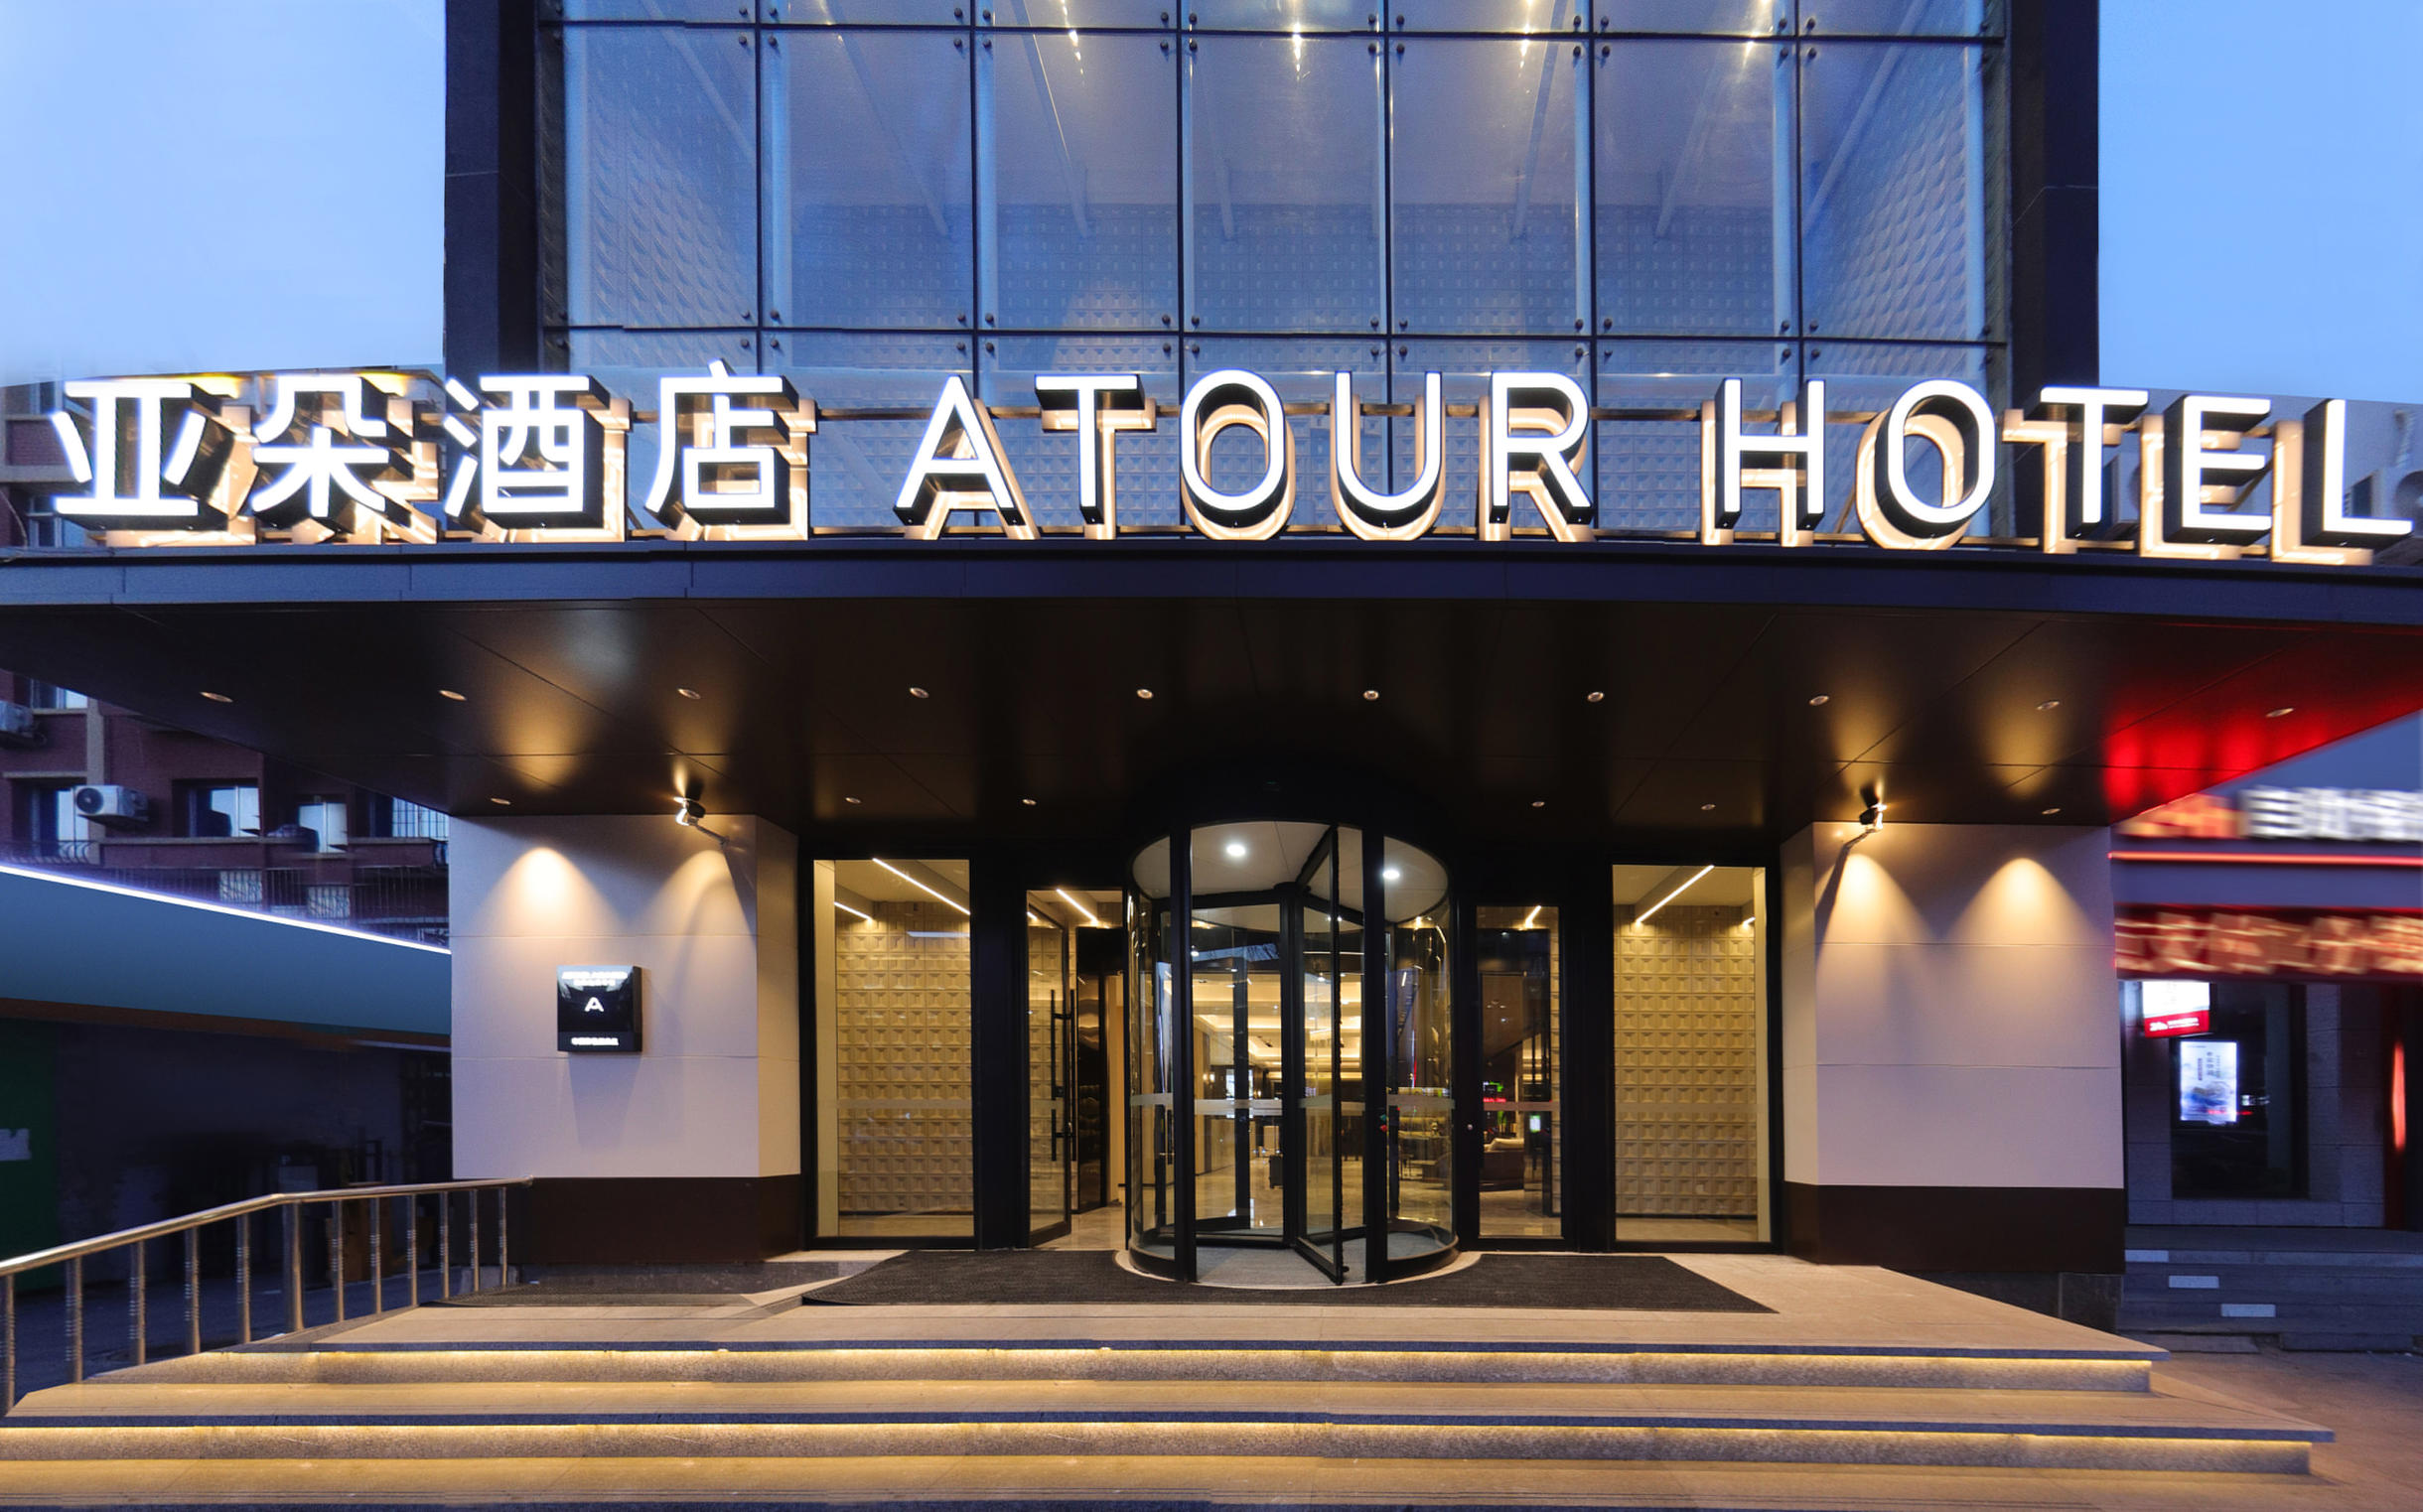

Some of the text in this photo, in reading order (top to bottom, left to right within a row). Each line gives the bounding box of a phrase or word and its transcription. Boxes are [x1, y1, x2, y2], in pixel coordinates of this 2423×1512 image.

[51, 360, 788, 519] 亚朵酒店
[895, 368, 2413, 536] ATOUR HOTEL
[584, 997, 605, 1013] A
